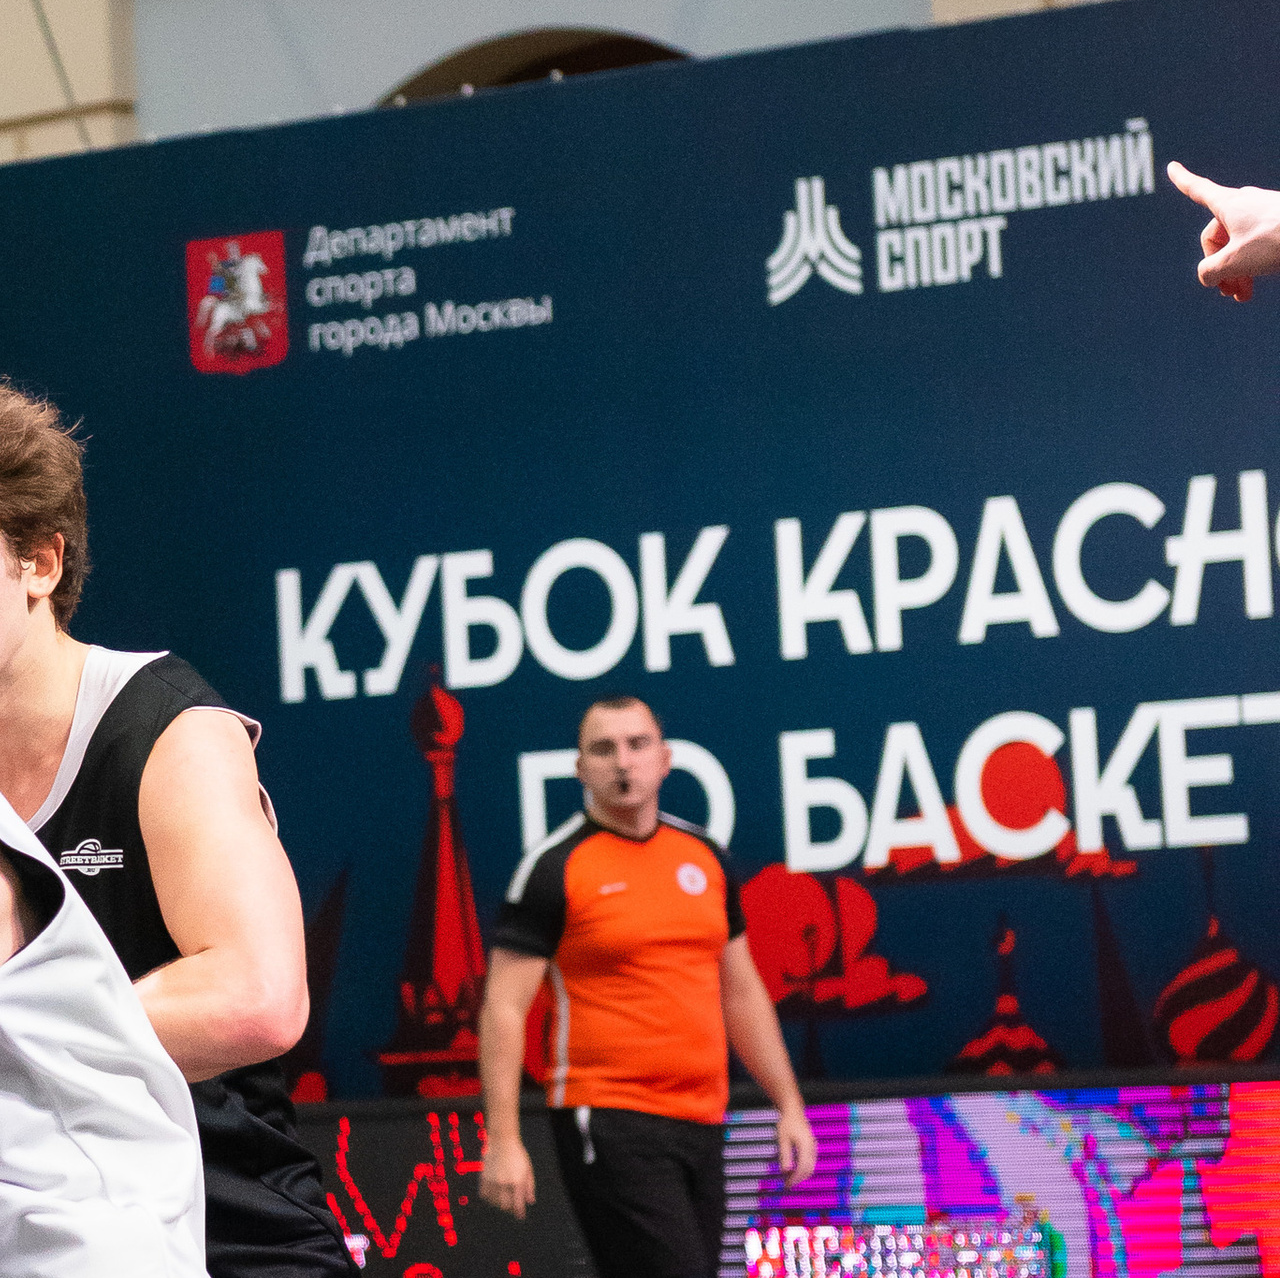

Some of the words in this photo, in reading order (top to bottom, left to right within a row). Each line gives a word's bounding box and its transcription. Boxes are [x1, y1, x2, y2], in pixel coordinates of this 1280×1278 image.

[873, 117, 1155, 229] МОСКОВСКИЙ
[303, 207, 515, 268] Департамент
[877, 215, 1007, 293] СПОРТ
[306, 266, 416, 308] спорта
[309, 312, 419, 357] города
[424, 295, 553, 338] Москвы
[275, 525, 735, 703] КУБОК
[774, 469, 1280, 661] КРАСН
